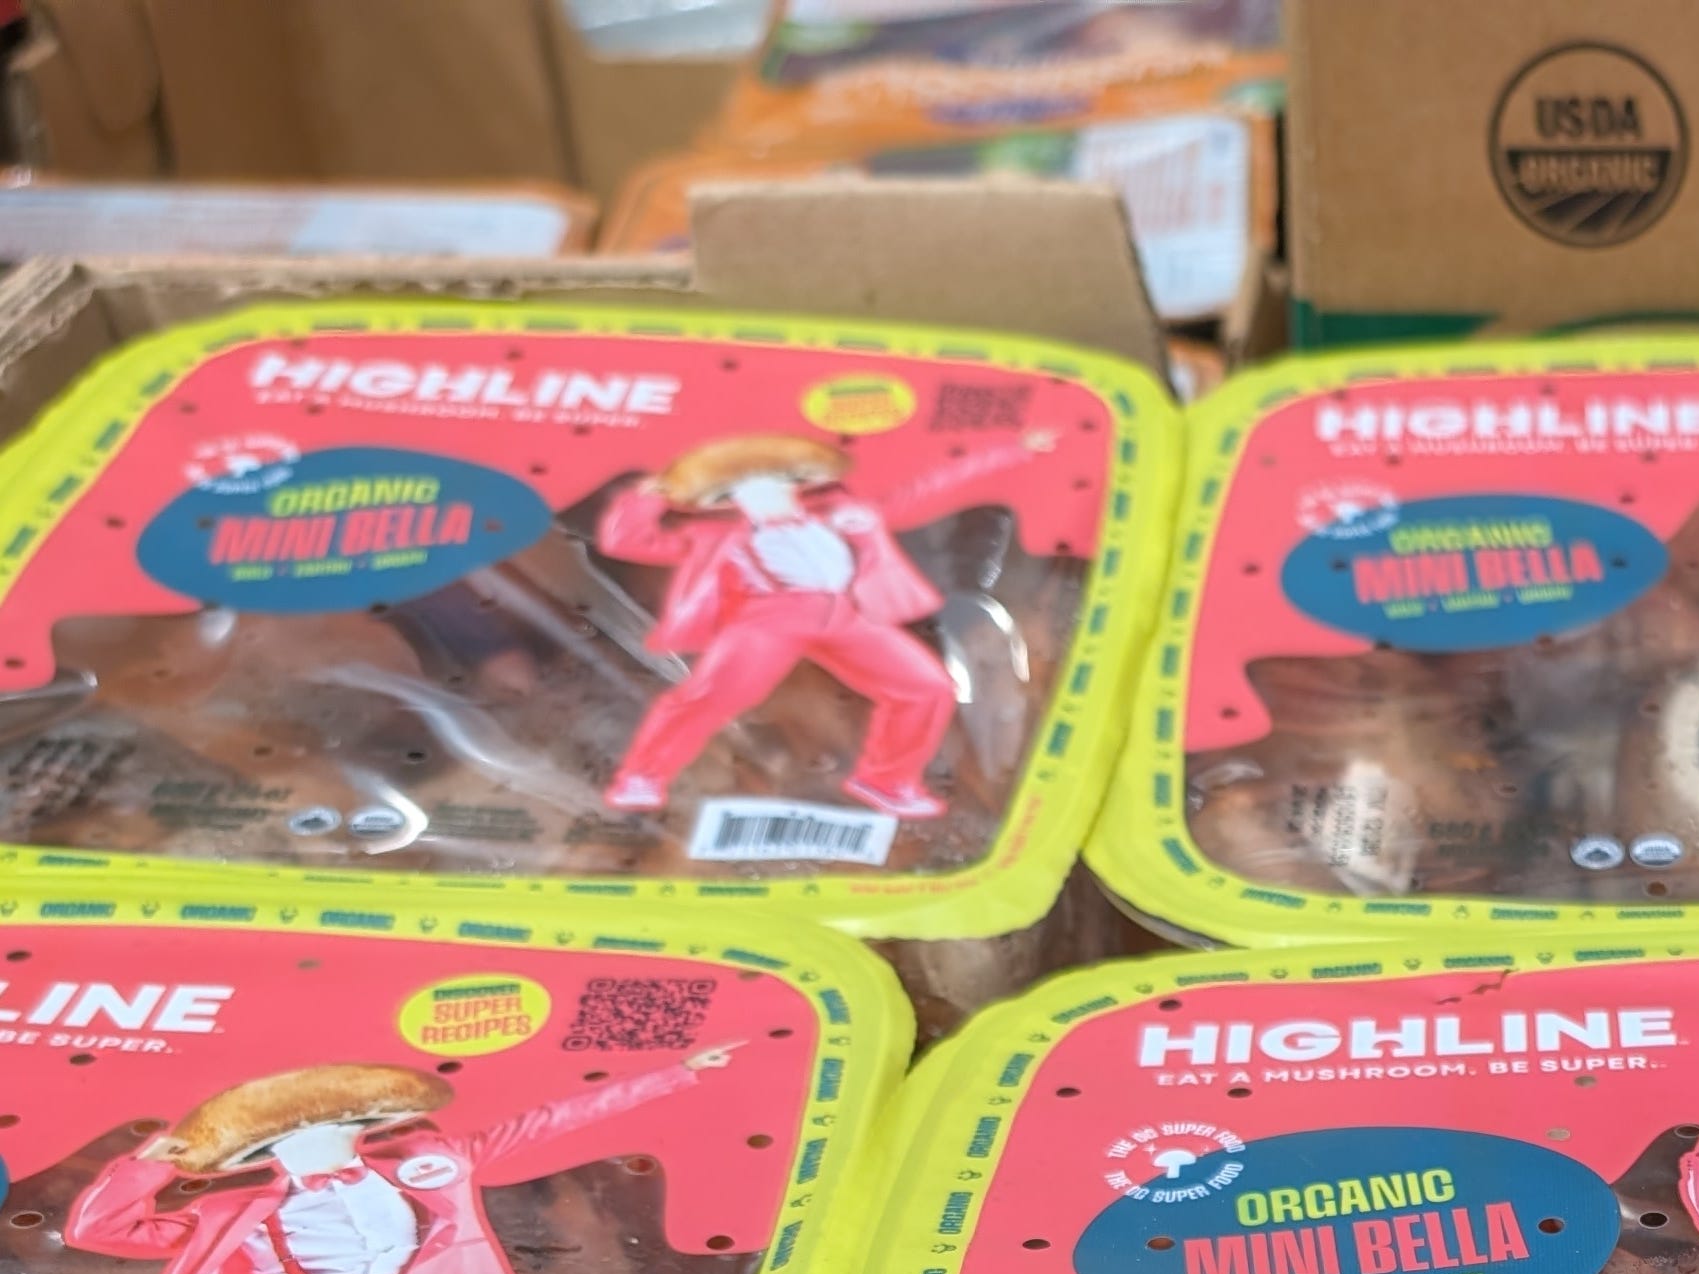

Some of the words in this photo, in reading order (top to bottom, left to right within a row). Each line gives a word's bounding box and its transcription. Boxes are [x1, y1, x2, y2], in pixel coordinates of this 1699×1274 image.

[1535, 97, 1644, 139] USDA
[249, 353, 681, 415] HIGHLINE
[269, 477, 440, 517] ORGANIC
[209, 515, 336, 565] MINI
[340, 504, 473, 556] BELLA
[1388, 517, 1553, 554] ORGANIC
[1352, 551, 1469, 606] MINI
[1473, 539, 1606, 591] BELLA
[422, 1015, 531, 1044] RECIPES
[434, 997, 522, 1023] SUPER
[1139, 1009, 1677, 1066] HIGHLINE
[1157, 1071, 1218, 1086] EAT
[1230, 1070, 1251, 1084] A
[1264, 1062, 1477, 1083] MUSHROOM.
[1489, 1060, 1530, 1074] BE
[1107, 1139, 1138, 1159] THE
[1161, 1122, 1217, 1137] SUPER
[1213, 1130, 1246, 1154] FOOD
[1104, 1170, 1133, 1190] THE
[1151, 1185, 1211, 1204] SUPER
[1207, 1162, 1244, 1190] FOOD
[1236, 1168, 1456, 1227] ORGANIC
